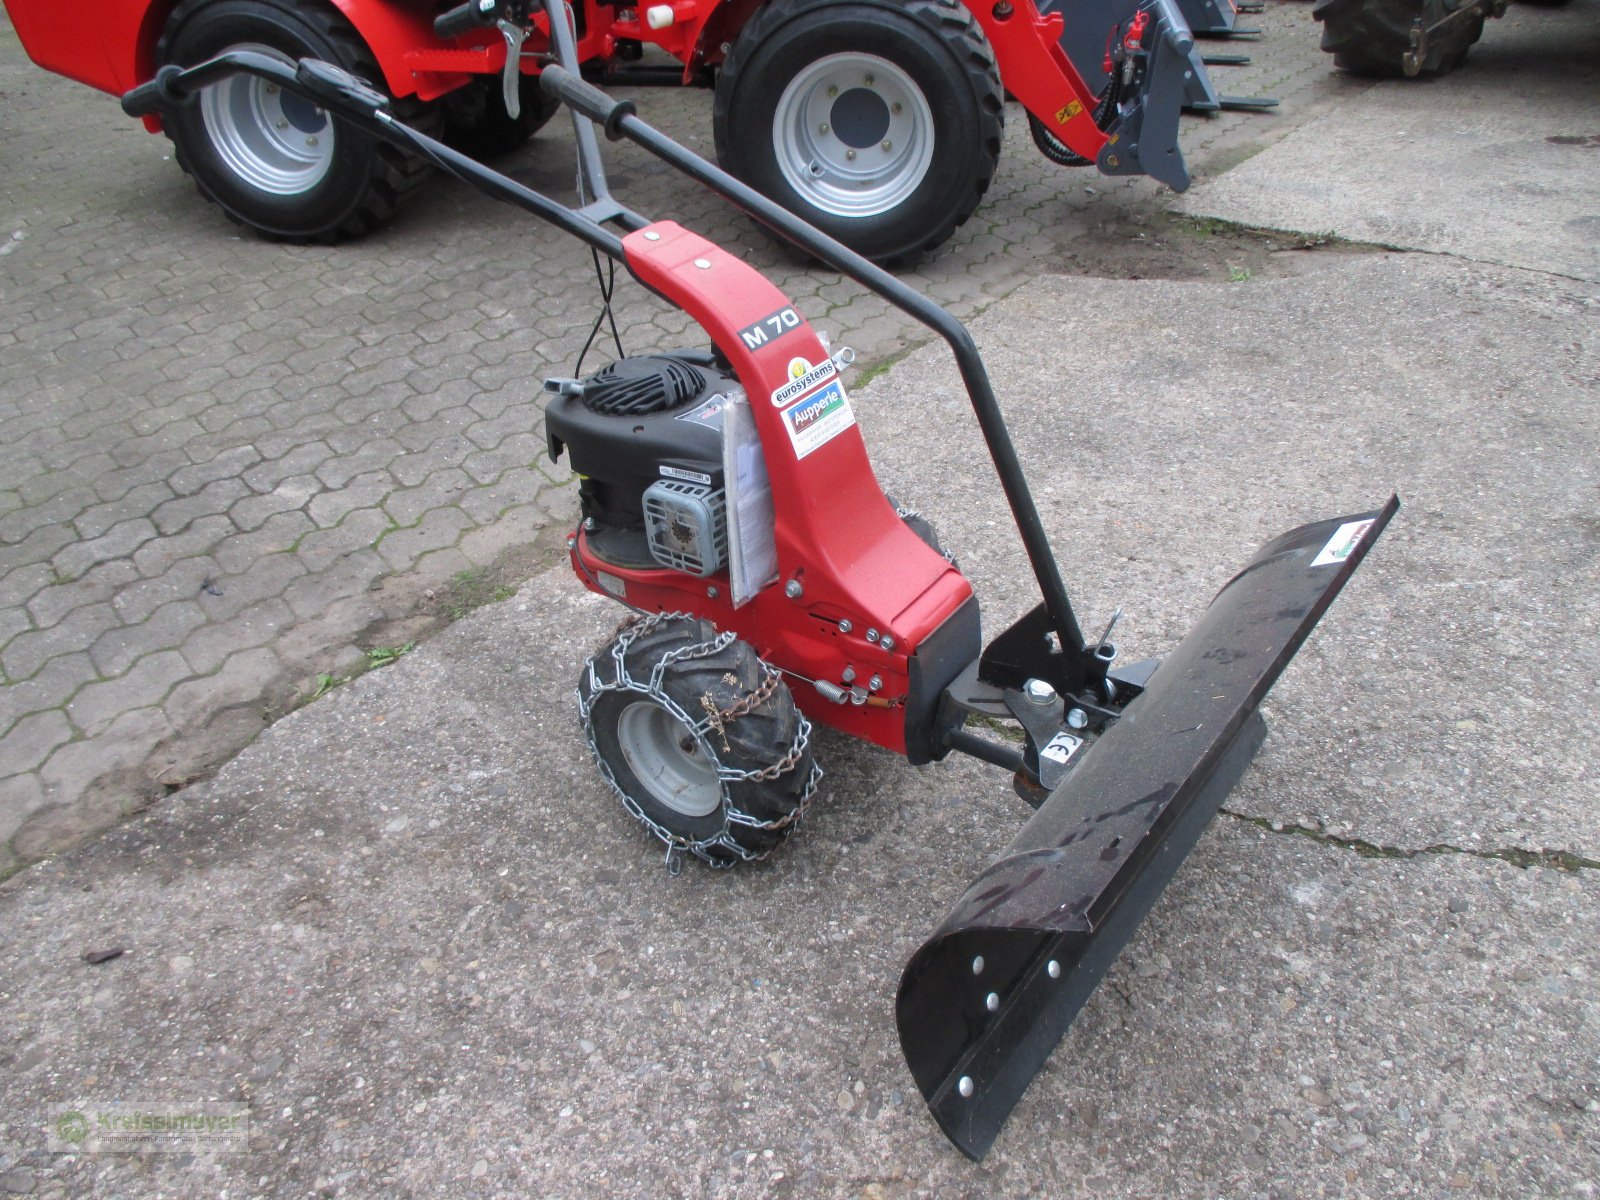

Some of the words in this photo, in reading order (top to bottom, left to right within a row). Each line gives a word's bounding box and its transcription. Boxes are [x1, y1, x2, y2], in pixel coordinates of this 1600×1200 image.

[742, 326, 768, 349] M
[767, 308, 800, 334] 70
[776, 363, 833, 402] eurosystems
[794, 390, 839, 426] Aupperle
